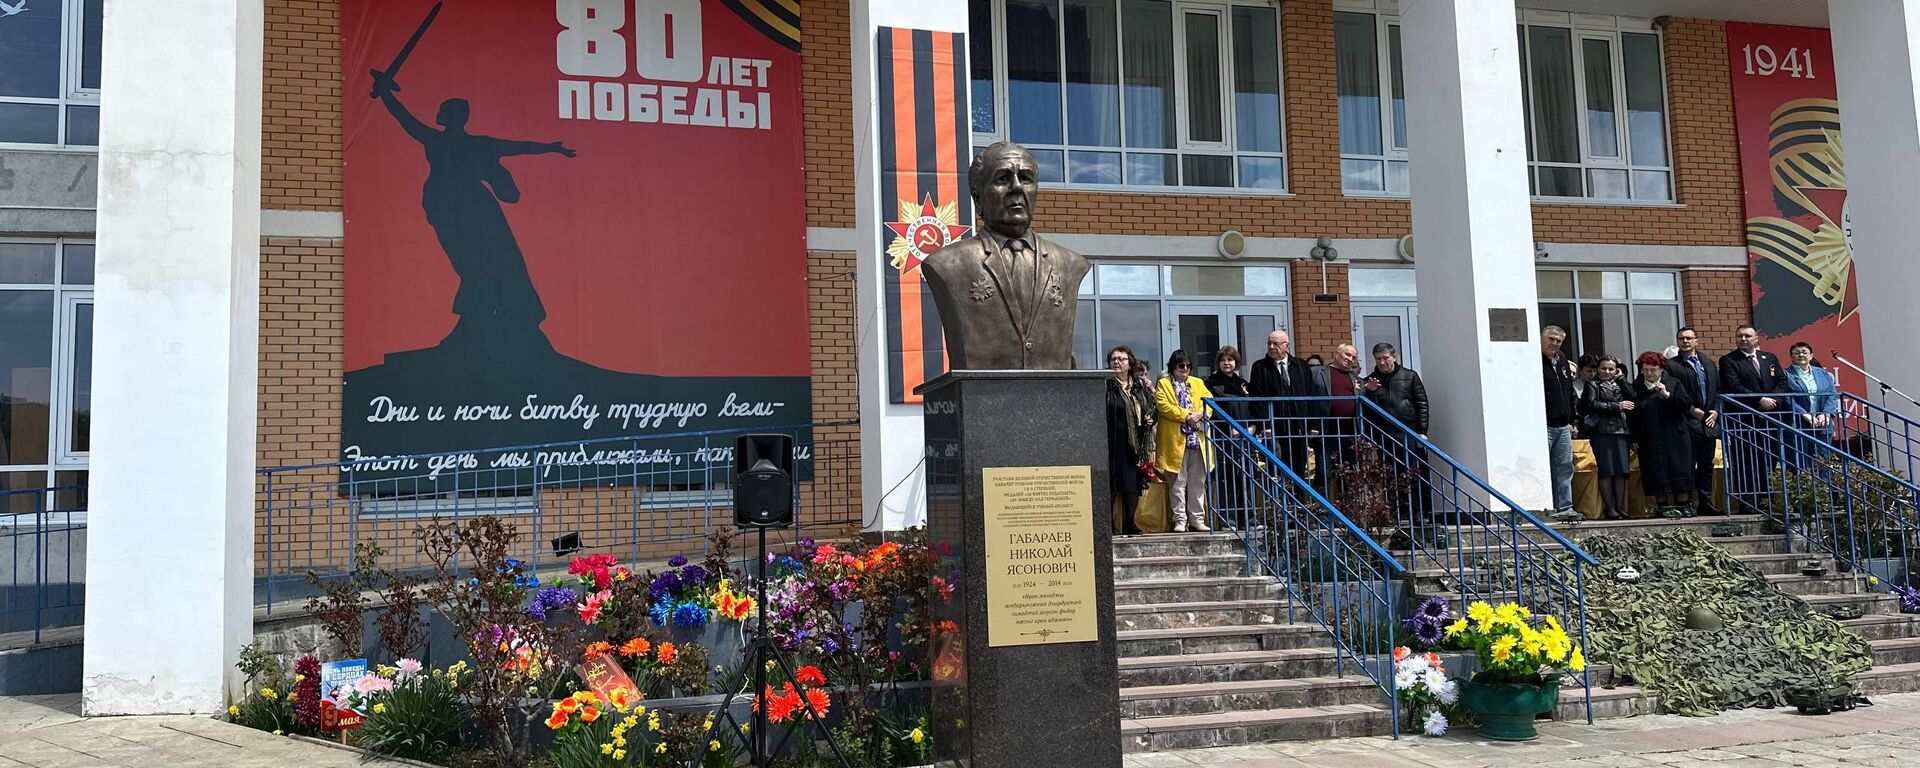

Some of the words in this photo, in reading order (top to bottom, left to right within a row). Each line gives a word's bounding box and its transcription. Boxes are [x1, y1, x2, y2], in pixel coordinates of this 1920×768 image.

[556, 0, 703, 82] 80
[707, 56, 772, 87] ЛЕТ
[1743, 44, 1815, 79] 1941
[558, 80, 771, 129] ПОБЕДЫ
[367, 396, 420, 422] Дни
[428, 406, 445, 421] и
[454, 405, 512, 421] ночи
[520, 394, 600, 429] битву
[608, 402, 707, 429] трудную
[340, 446, 418, 472] Этот
[428, 452, 478, 480] день
[490, 452, 531, 468] мы
[1010, 532, 1072, 544] ГАБАРАЕВ
[1010, 544, 1072, 559] НИКОЛАЙ
[1007, 562, 1076, 575] ЯСОНОВИЧ
[325, 705, 338, 726] 9
[338, 716, 361, 726] мая
